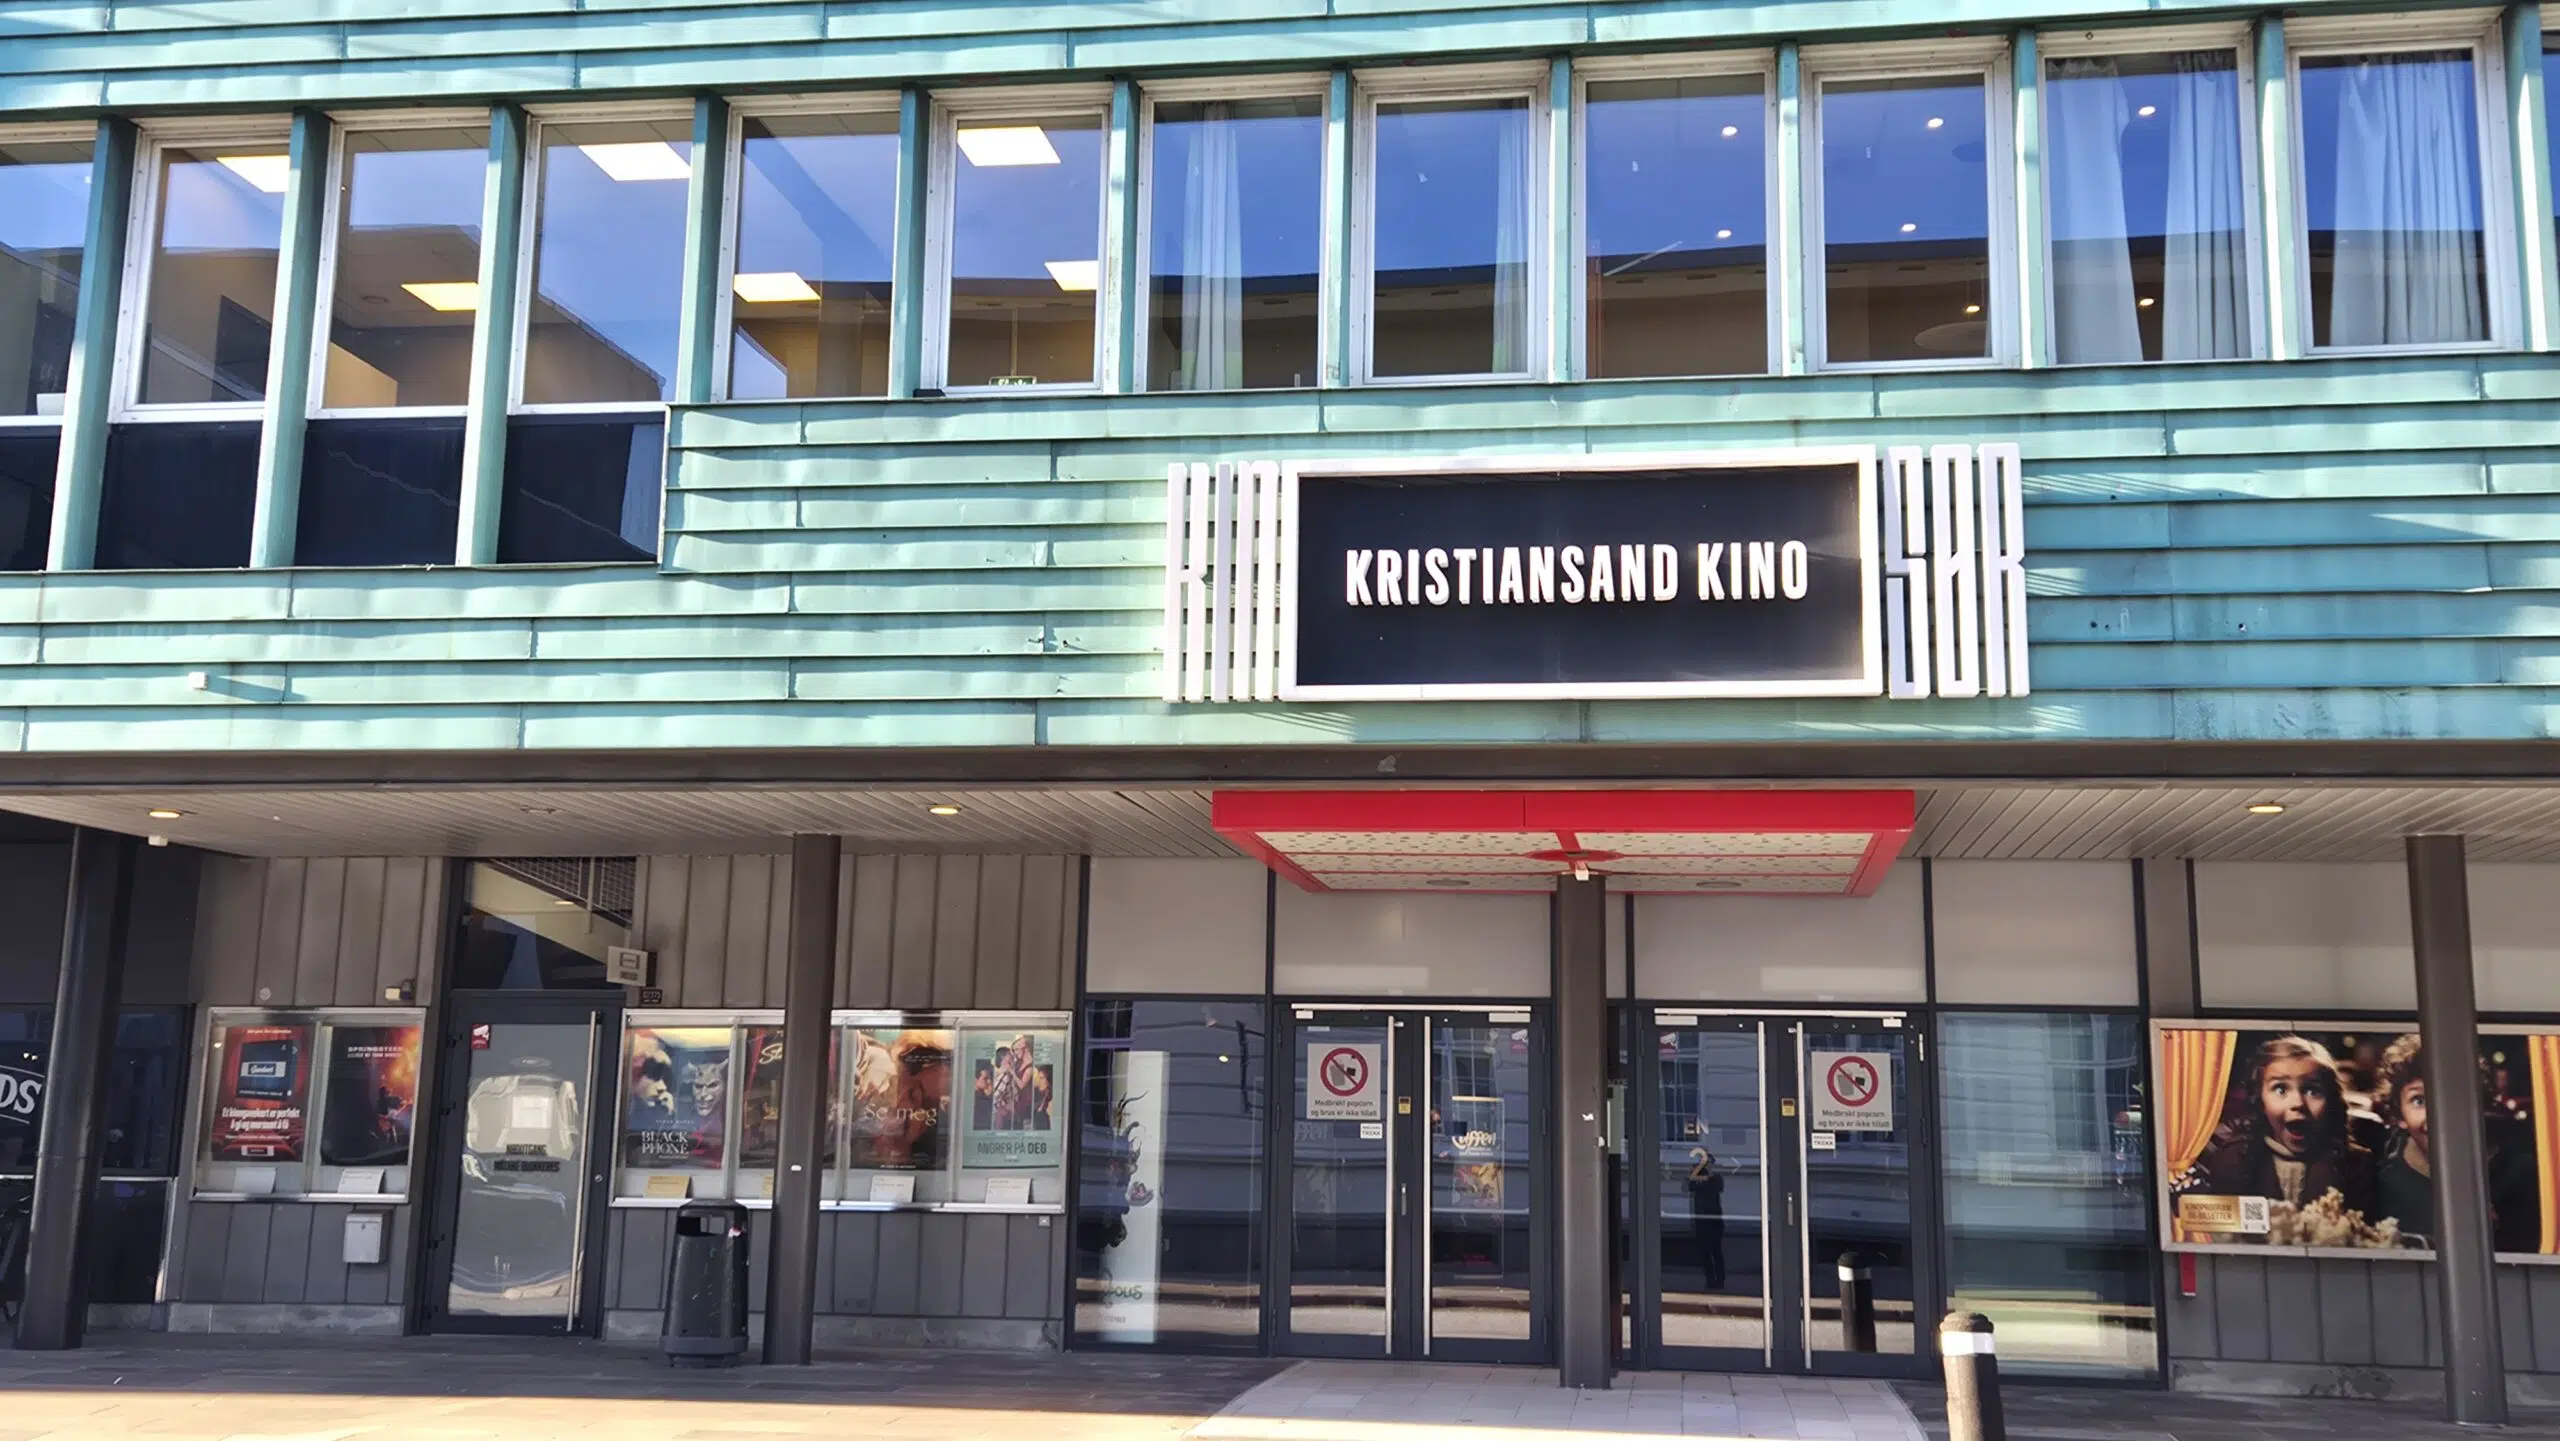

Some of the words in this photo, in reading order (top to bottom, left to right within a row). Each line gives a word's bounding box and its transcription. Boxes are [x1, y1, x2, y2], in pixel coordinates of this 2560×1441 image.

[1345, 542, 1680, 607] KRISTIANSAND
[1698, 539, 1810, 601] KINO
[1883, 442, 2031, 701] SØR
[897, 1107, 937, 1127] meg
[1822, 1109, 1855, 1117] Medbrakt
[1856, 1110, 1885, 1118] popcorn
[641, 1130, 688, 1142] BLACK
[688, 1130, 705, 1154] 2
[642, 1141, 689, 1154] PHONE
[977, 1142, 1012, 1154] ANGRER
[1014, 1139, 1026, 1154] PÅ
